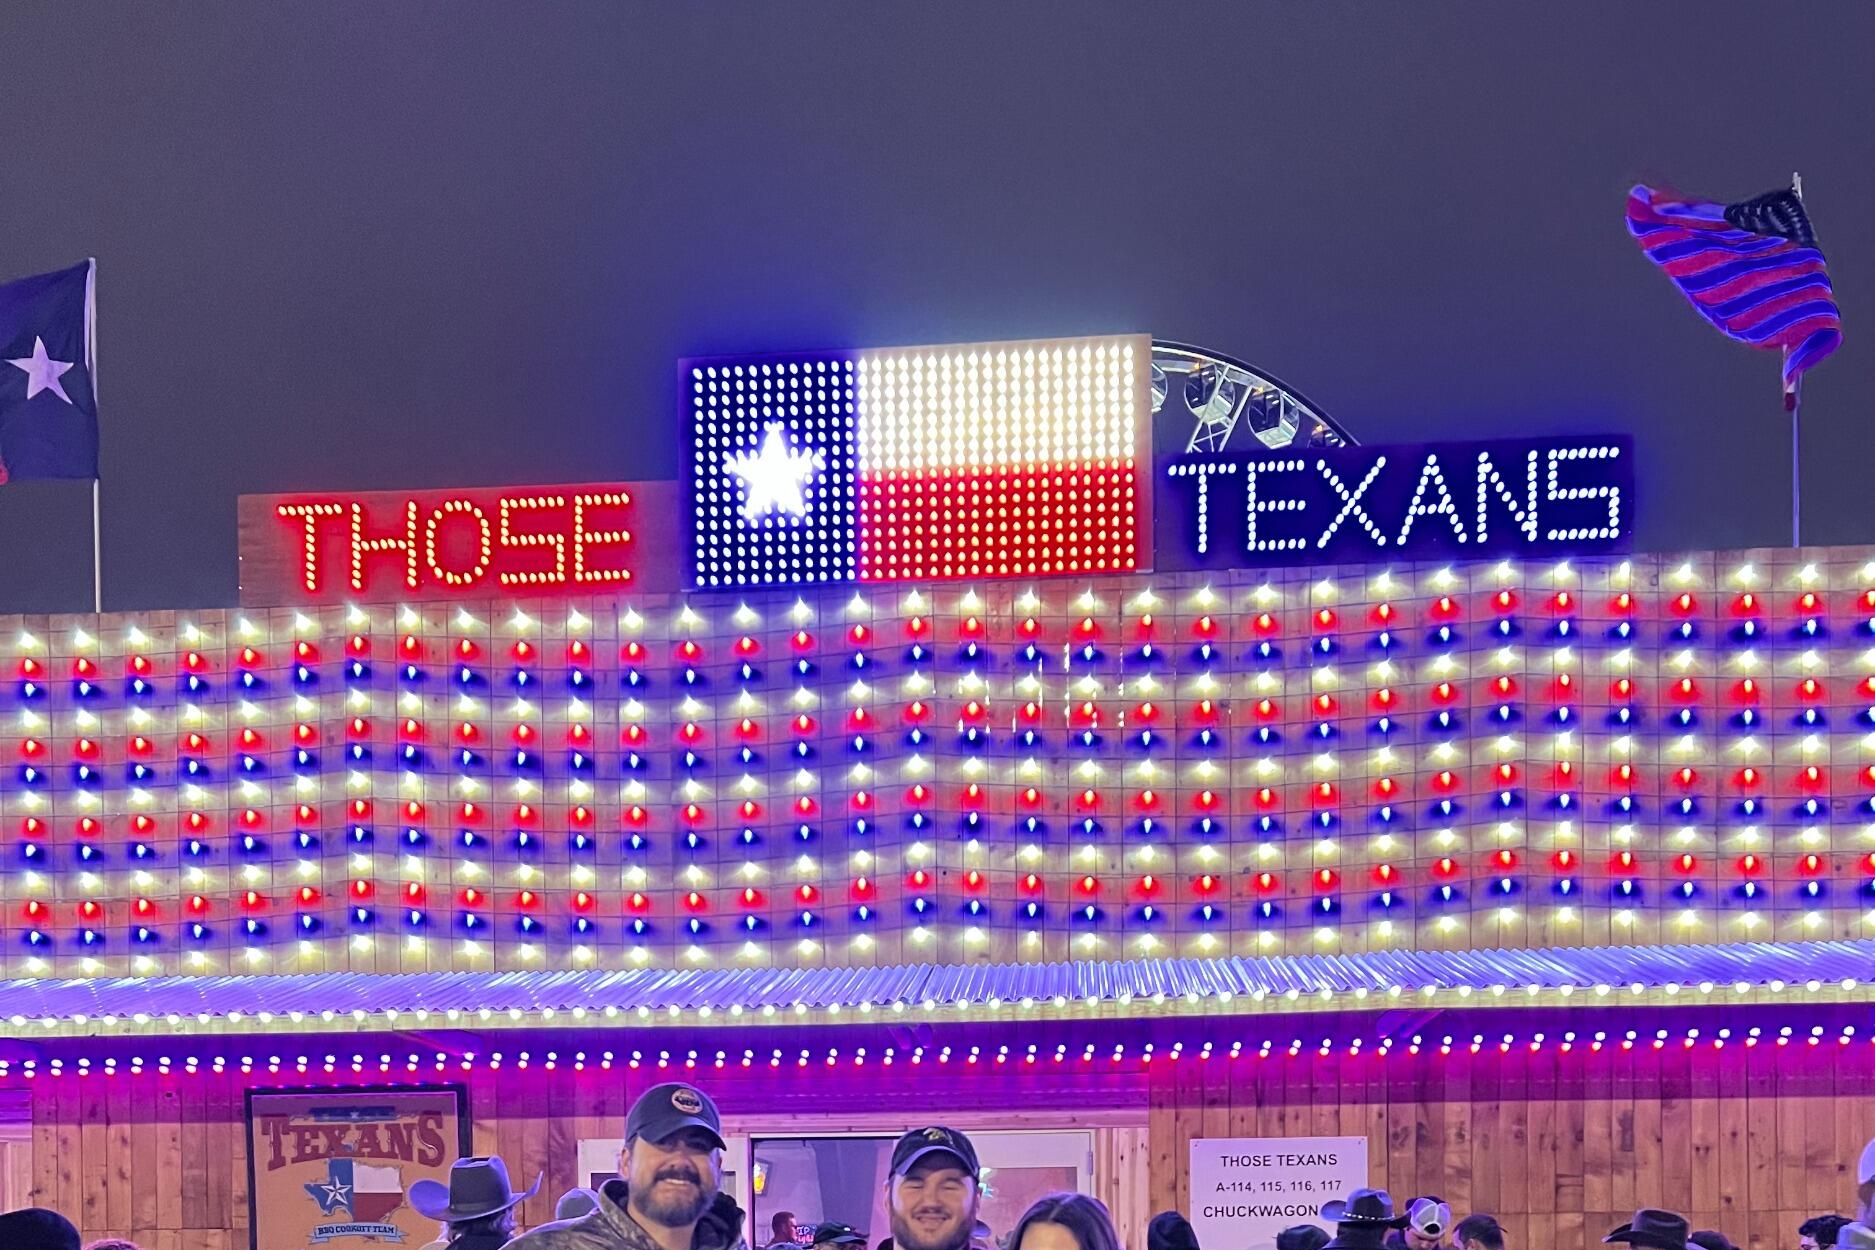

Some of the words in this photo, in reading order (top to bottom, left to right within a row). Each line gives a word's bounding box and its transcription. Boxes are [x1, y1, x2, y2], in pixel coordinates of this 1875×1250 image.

[277, 491, 632, 592] THOSE
[1167, 445, 1621, 555] TEXANS
[261, 1111, 446, 1172] TEXANS
[1220, 1155, 1272, 1168] THOSE
[1277, 1153, 1338, 1167] TEXANS
[1216, 1181, 1256, 1194] A-114,
[1260, 1181, 1286, 1194] 115,
[1290, 1180, 1316, 1193] 116,
[1320, 1180, 1342, 1192] 117
[1203, 1204, 1319, 1218] CHUCKWAGON
